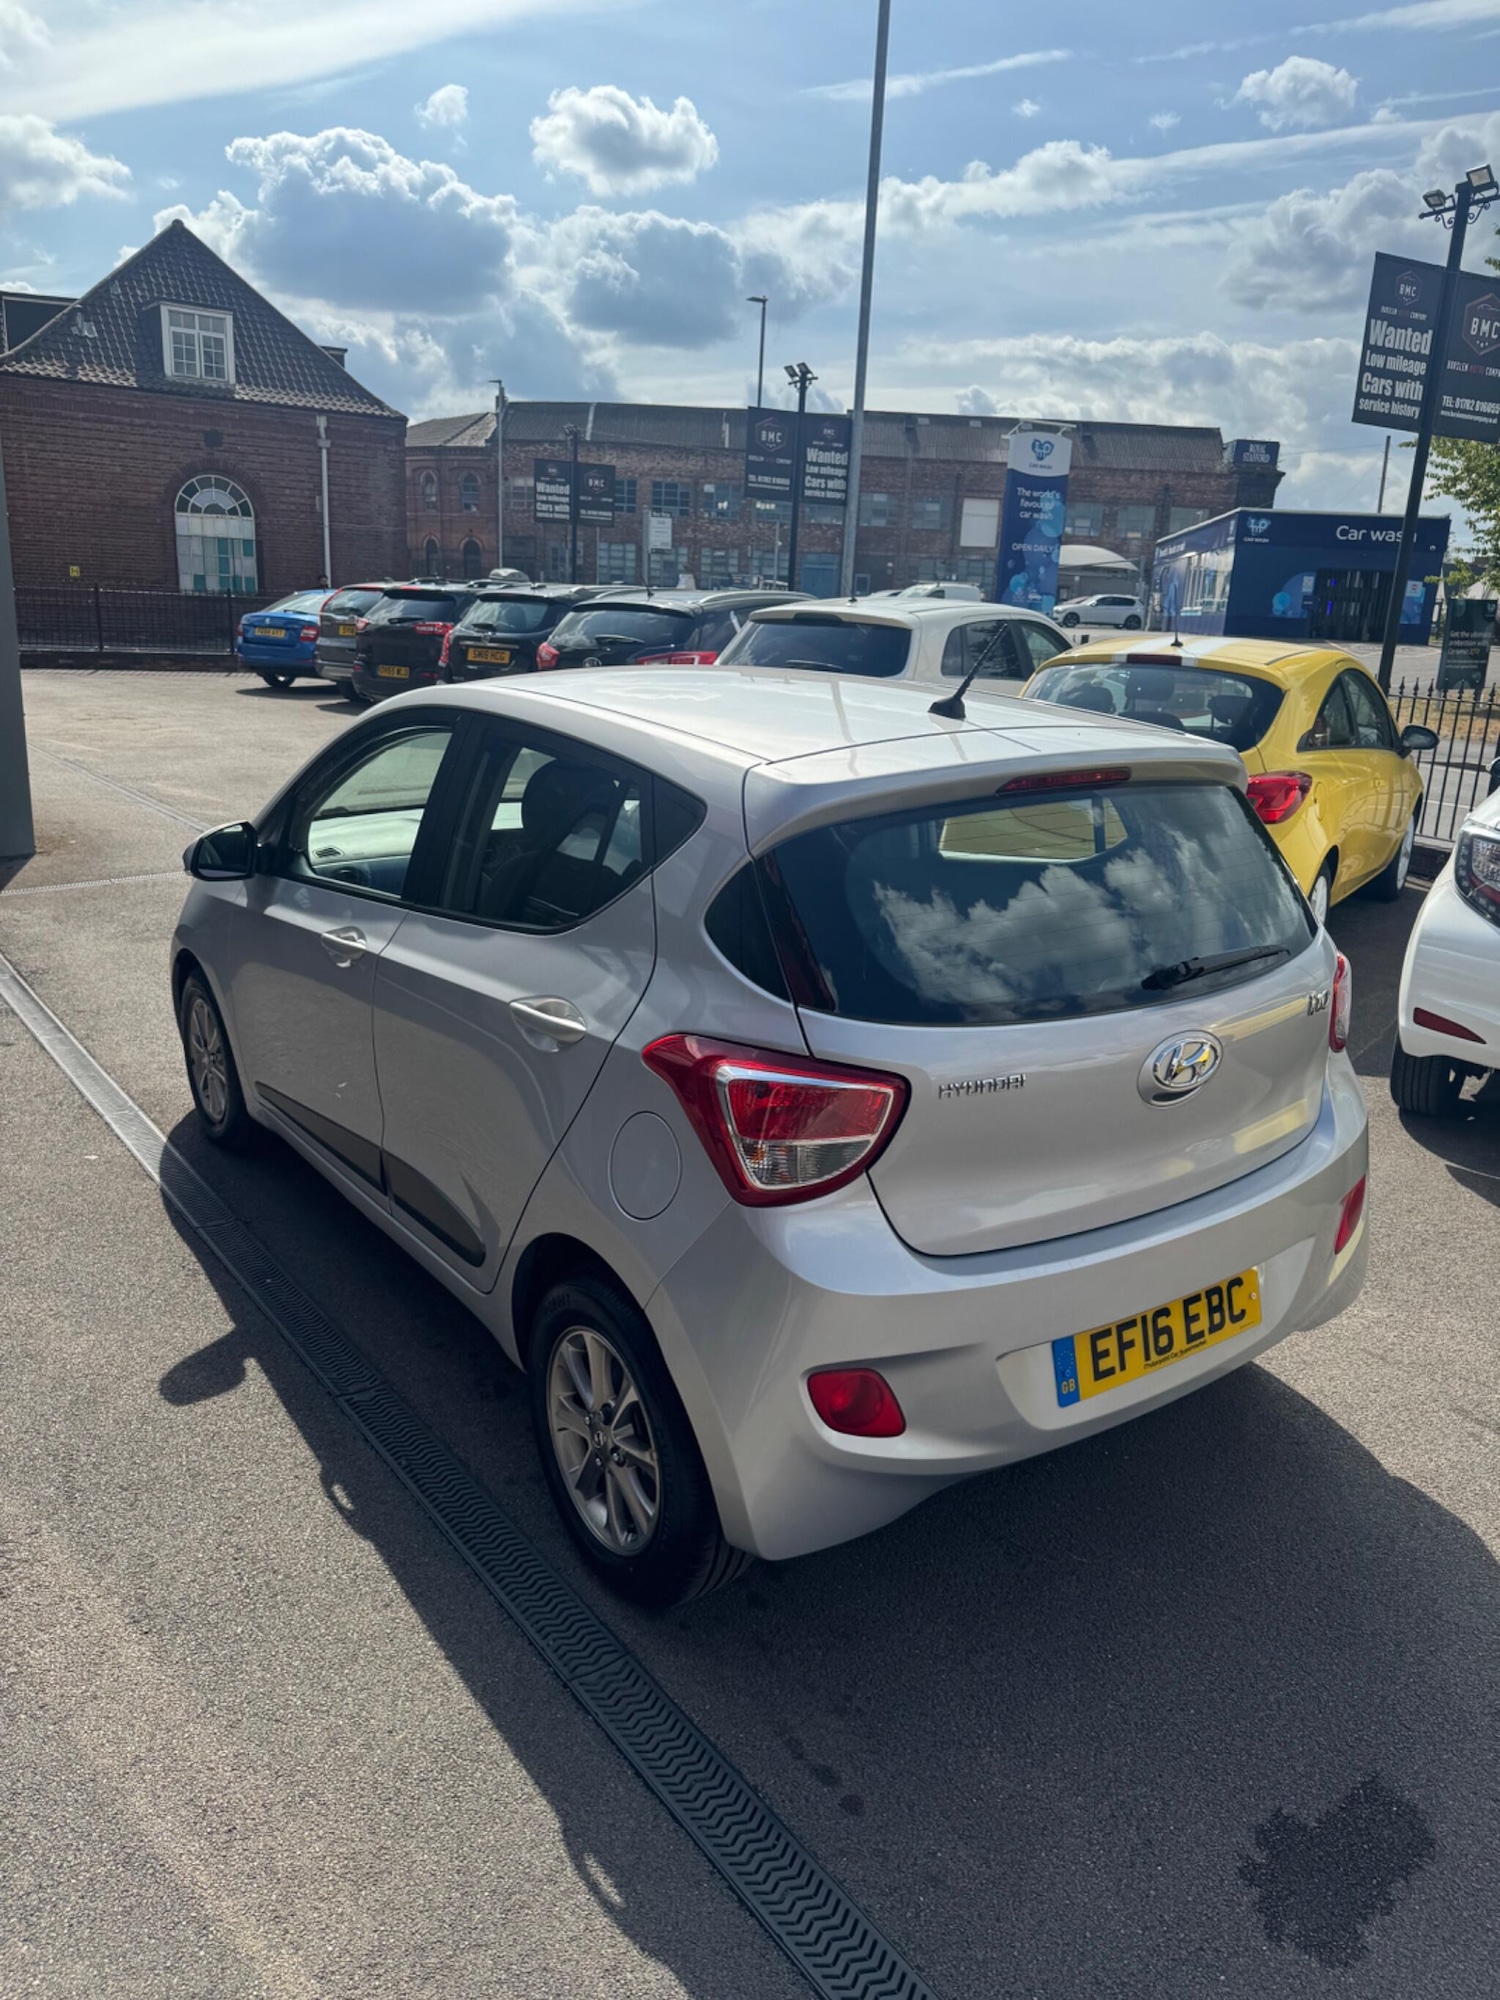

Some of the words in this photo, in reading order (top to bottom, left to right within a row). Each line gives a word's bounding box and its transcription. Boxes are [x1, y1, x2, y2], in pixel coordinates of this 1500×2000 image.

[1399, 284, 1417, 297] BMC
[1470, 317, 1500, 339] BMC
[1369, 319, 1433, 355] Wanted
[1365, 350, 1385, 367] Low
[1386, 355, 1427, 376] mileage
[1362, 372, 1393, 397] Cars
[1394, 378, 1424, 401] with
[1358, 397, 1390, 415] service
[1390, 402, 1421, 420] history
[761, 430, 782, 443] BMC
[806, 447, 849, 465] Wanted
[805, 463, 819, 474] Low
[820, 465, 847, 477] mileage
[536, 481, 570, 495] Wanted
[805, 475, 826, 489] Cars
[827, 478, 847, 490] with
[804, 489, 825, 498] service
[826, 490, 846, 500] history
[1016, 487, 1031, 497] The
[1032, 489, 1060, 500] world's
[536, 502, 553, 512] Cars
[554, 504, 570, 513] with
[1019, 509, 1032, 518] car
[1032, 510, 1054, 520] wash
[1336, 525, 1367, 541] Car
[1370, 530, 1417, 543] was
[1012, 542, 1032, 552] OPEN
[1033, 544, 1055, 553] DAILY
[939, 1074, 1025, 1099] HYUNDAI
[1090, 1306, 1174, 1382] EF16
[1183, 1276, 1247, 1345] EBC
[1061, 1378, 1076, 1394] GB
